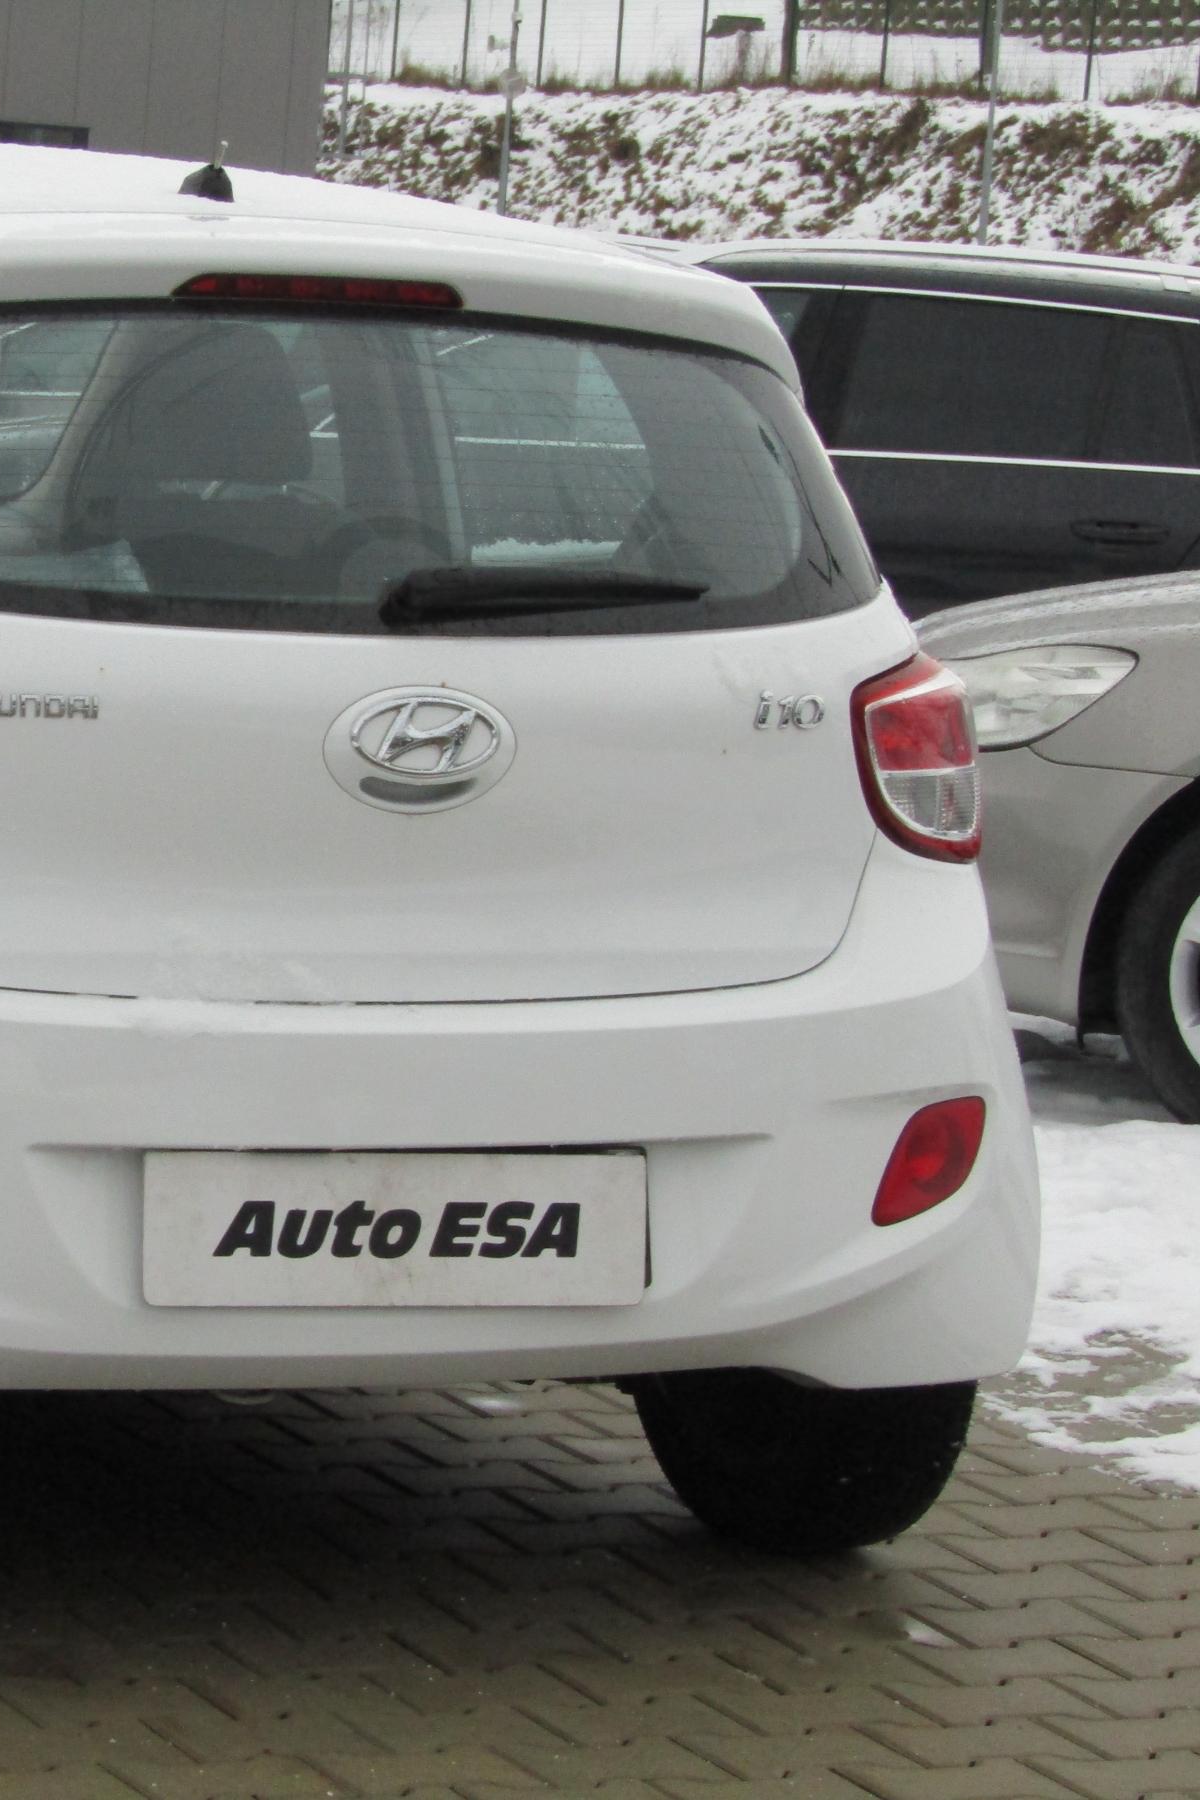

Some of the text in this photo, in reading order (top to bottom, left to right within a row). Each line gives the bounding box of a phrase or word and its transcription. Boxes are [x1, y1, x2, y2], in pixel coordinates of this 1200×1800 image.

[753, 689, 825, 730] i10
[212, 1200, 581, 1259] Auto ESA
